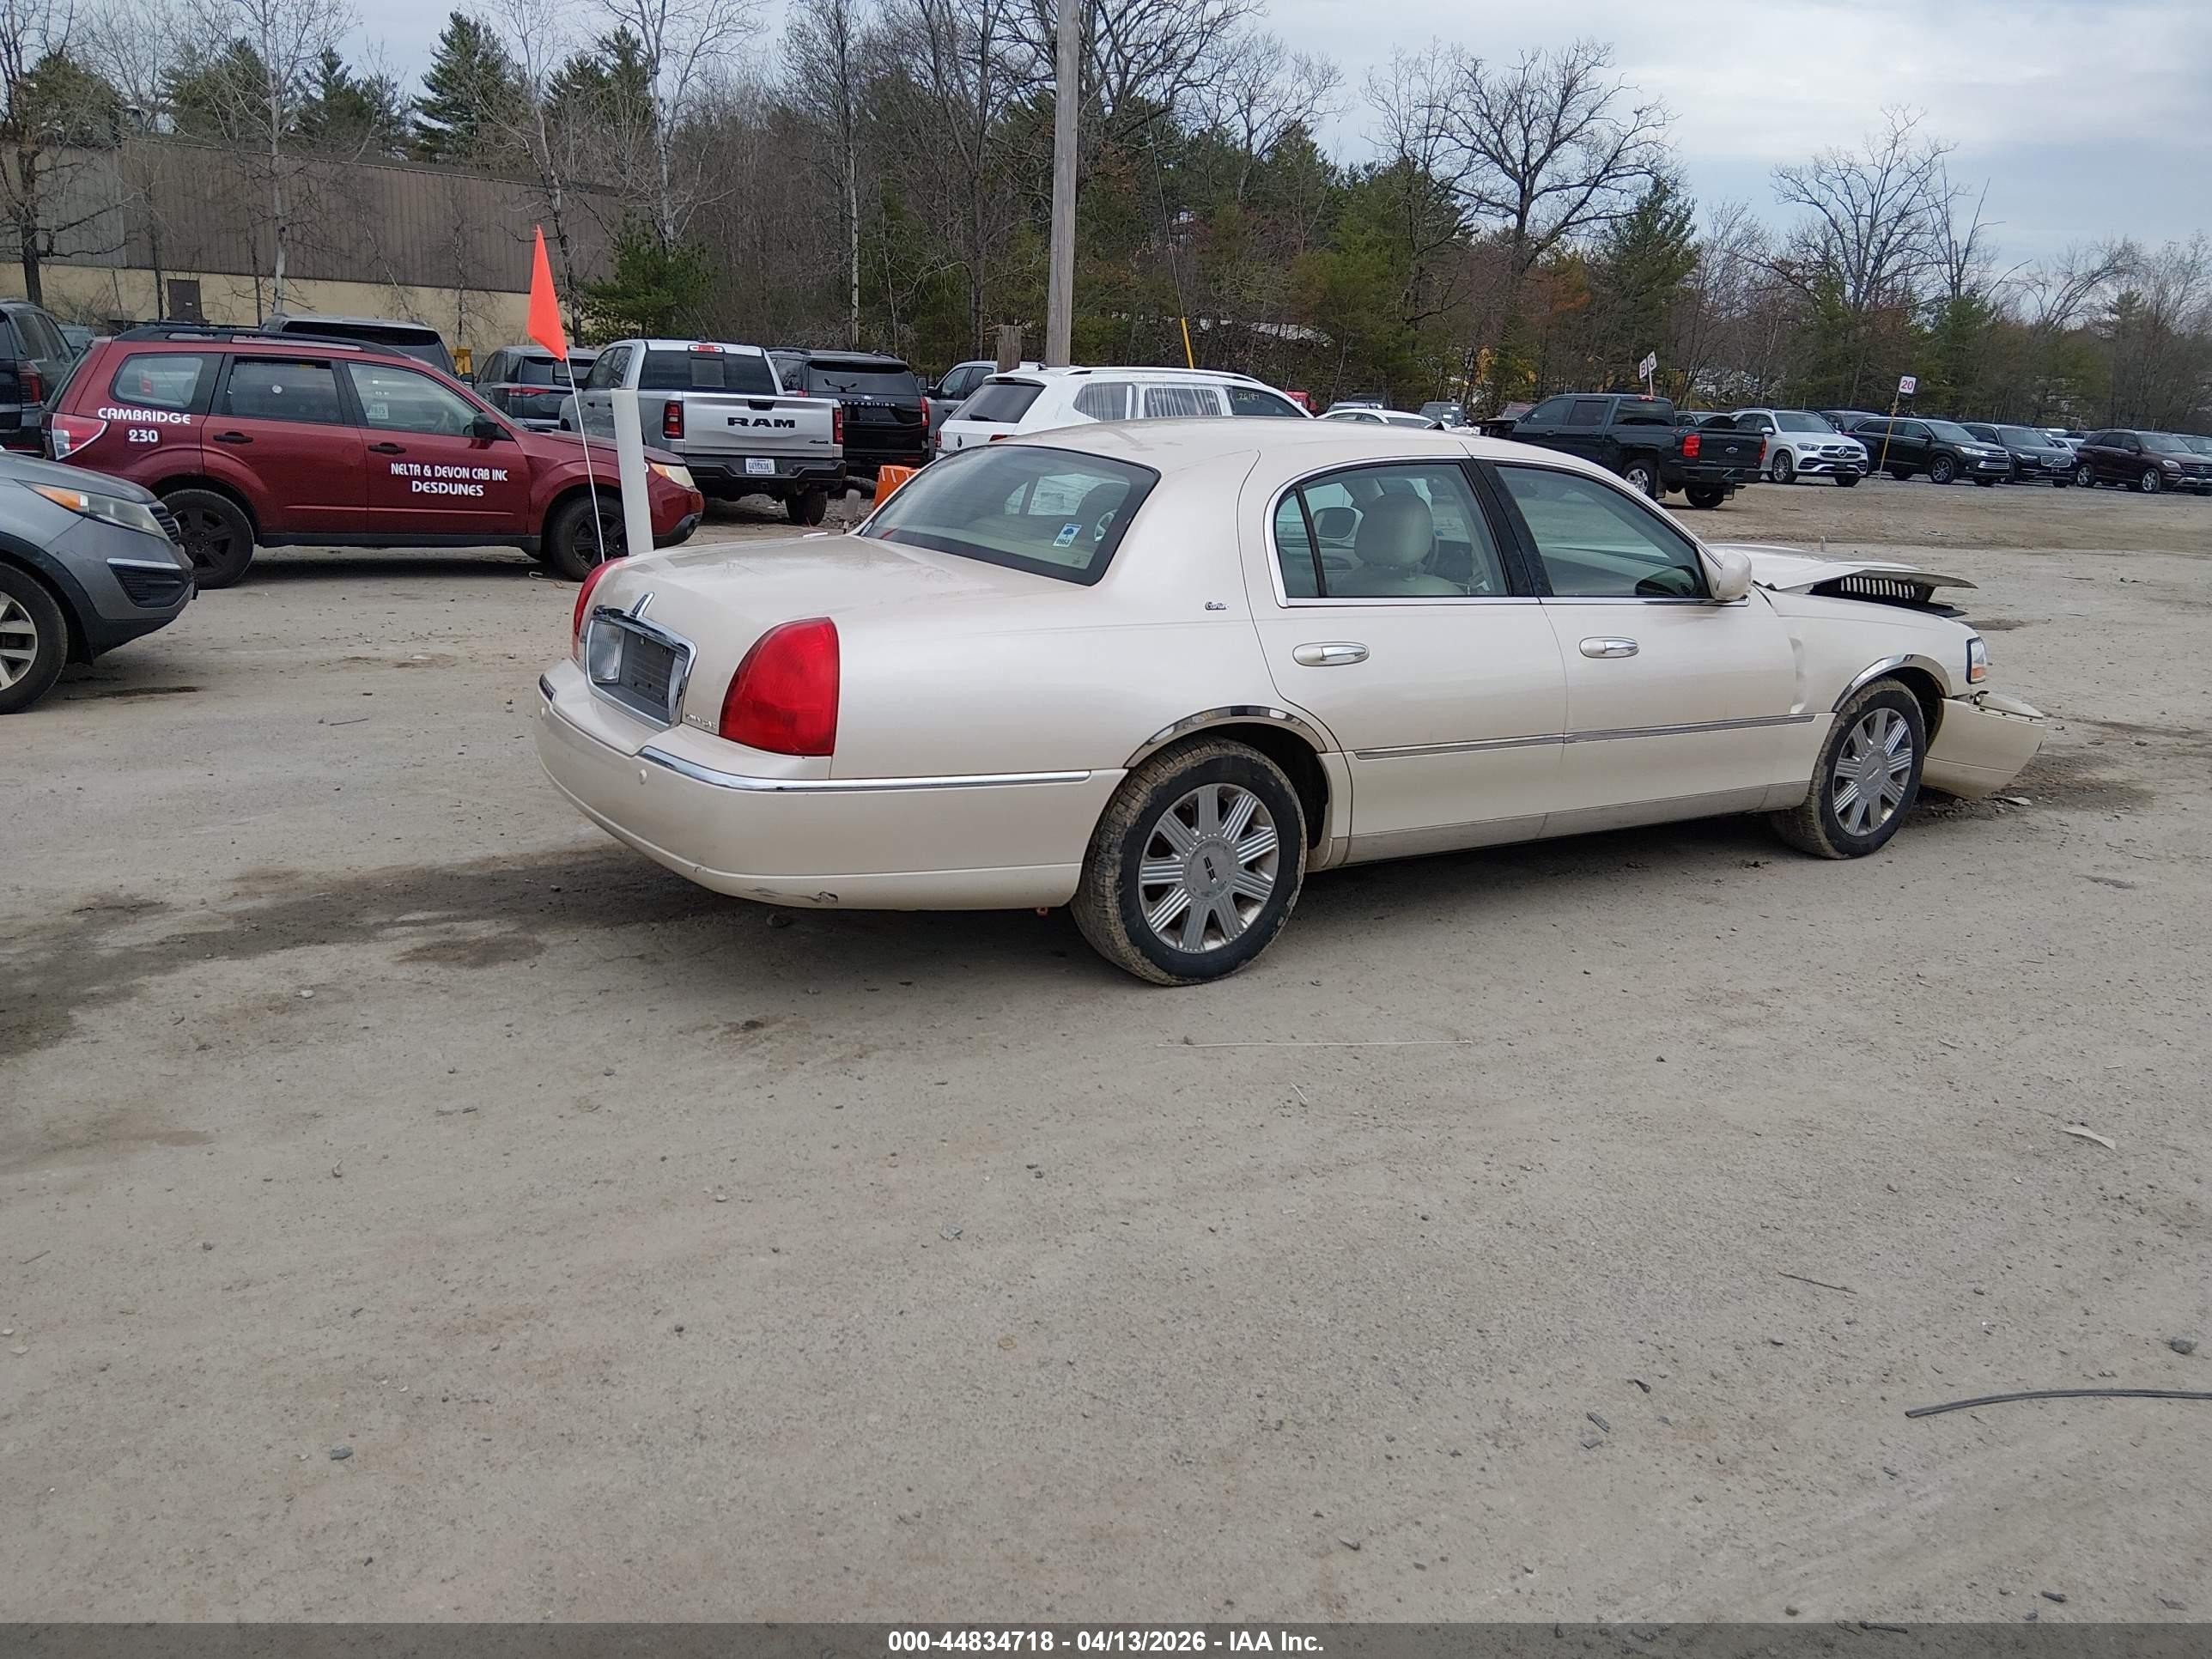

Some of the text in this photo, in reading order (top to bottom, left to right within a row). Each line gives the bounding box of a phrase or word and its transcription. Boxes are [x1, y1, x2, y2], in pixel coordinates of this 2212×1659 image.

[1900, 379, 1914, 391] 20
[97, 407, 191, 425] CAMBRIDGE
[727, 416, 796, 428] RAM
[128, 428, 159, 443] 230
[391, 462, 508, 482] NELTA & DEVON CAB INC
[411, 480, 484, 497] DESDUNES
